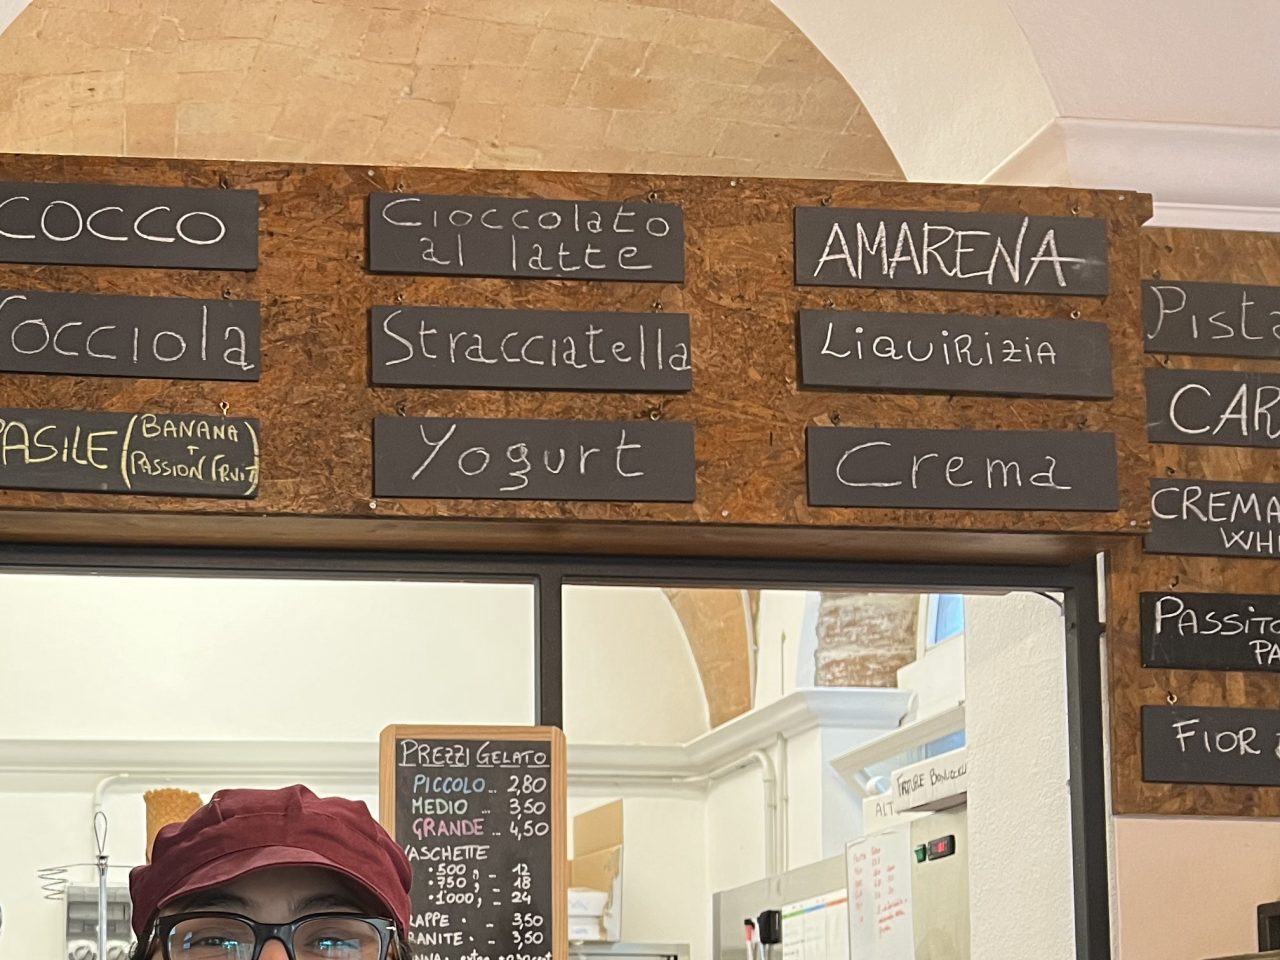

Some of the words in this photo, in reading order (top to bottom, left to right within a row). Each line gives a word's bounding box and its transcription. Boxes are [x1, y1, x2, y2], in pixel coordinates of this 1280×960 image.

[382, 197, 670, 241] Cioccolato
[419, 234, 464, 267] al
[511, 229, 657, 272] latte
[813, 216, 1086, 287] AMARENA
[383, 309, 692, 371] Stracciatella
[131, 451, 207, 482] PASSION
[411, 423, 644, 492] Yogurt
[836, 441, 1072, 490] Crema
[1151, 485, 1280, 524] CREMA
[1220, 527, 1280, 554] WH
[1172, 718, 1261, 755] FIOR
[399, 738, 471, 766] PREZZI
[476, 740, 550, 766] GELATO
[412, 774, 487, 795] PICCOLO
[506, 774, 548, 796] 2,80
[411, 796, 469, 816] MEDIO
[509, 798, 547, 820] 3,50
[411, 817, 486, 842] GRANDE
[508, 820, 550, 842] 4,50
[435, 862, 467, 876] 500
[511, 863, 531, 876] 12
[436, 875, 468, 890] 750
[513, 876, 532, 890] 18
[511, 891, 532, 905] 24
[512, 912, 544, 930] 3,50
[408, 931, 464, 947] RANITE
[511, 931, 544, 950] 3,50
